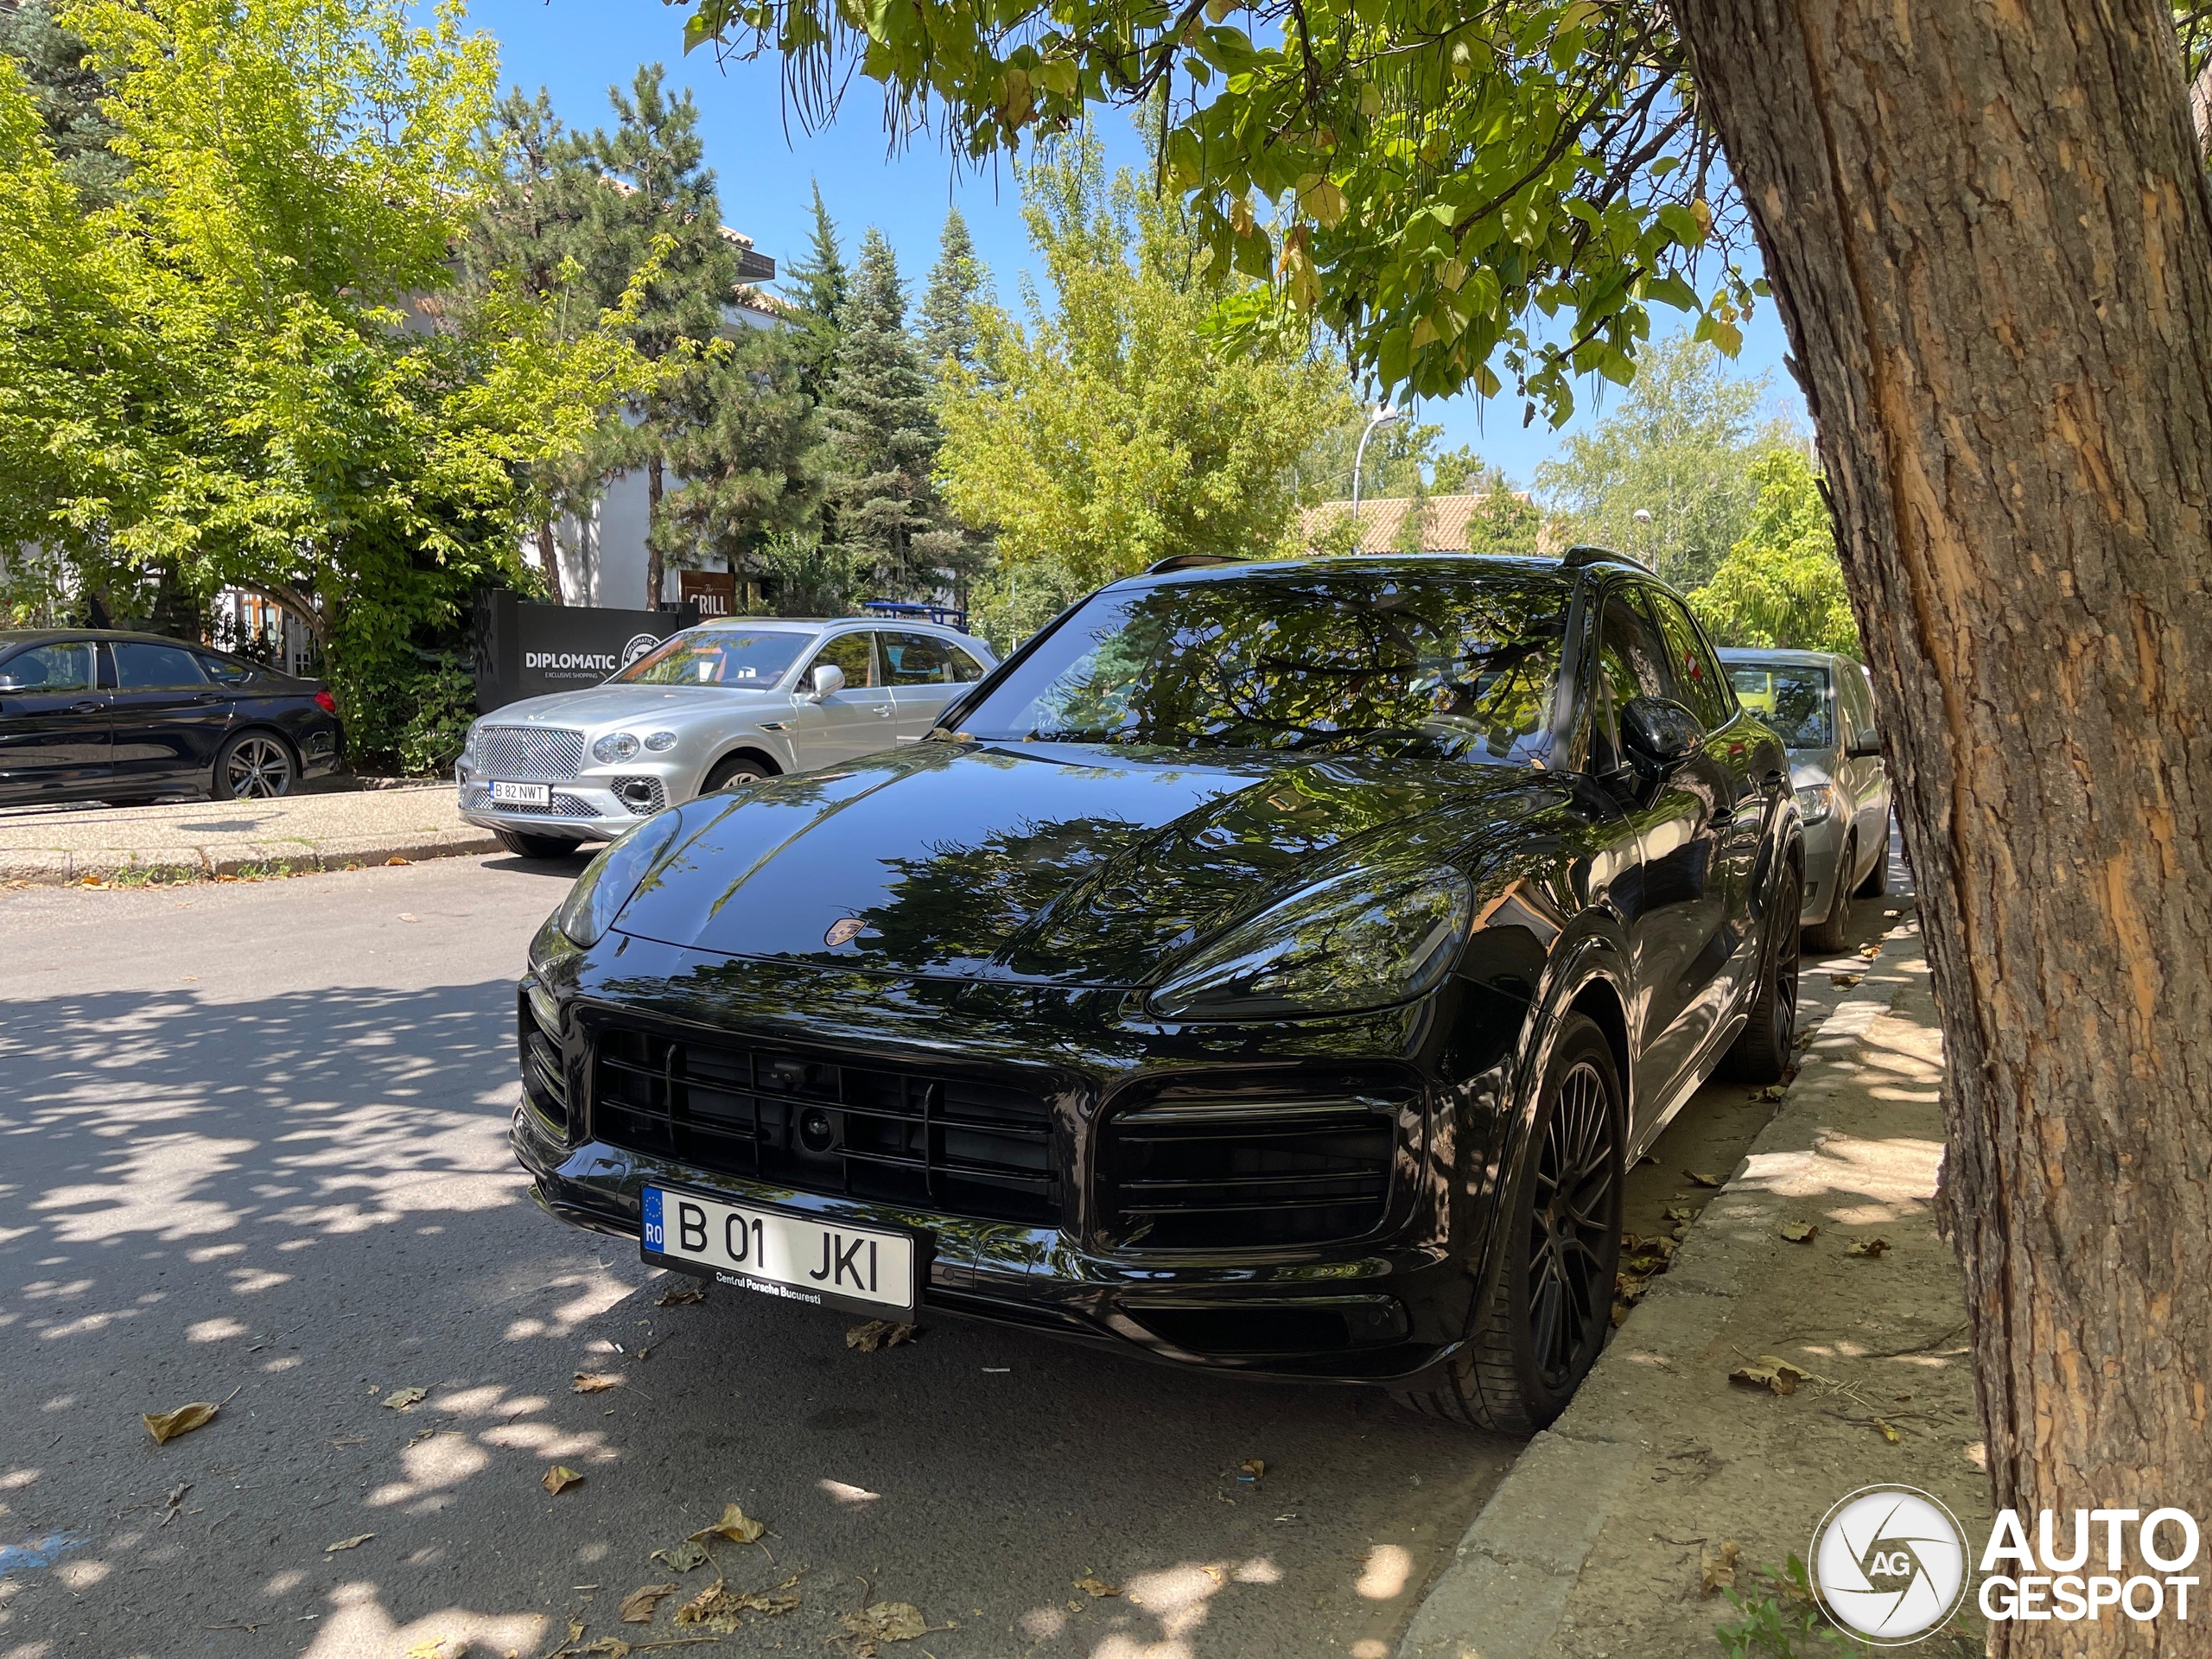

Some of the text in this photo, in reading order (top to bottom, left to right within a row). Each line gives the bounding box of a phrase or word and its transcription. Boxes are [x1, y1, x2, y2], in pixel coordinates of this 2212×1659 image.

[626, 638, 653, 658] DIPLOMATIC
[525, 652, 616, 670] DIPLOMATIC
[496, 785, 502, 796] B
[505, 785, 516, 798] 82
[520, 785, 543, 799] NWT
[645, 1223, 663, 1244] RO
[679, 1202, 877, 1293] B 01 JKI
[716, 1272, 821, 1305] Centrul Porsche Bucuresti
